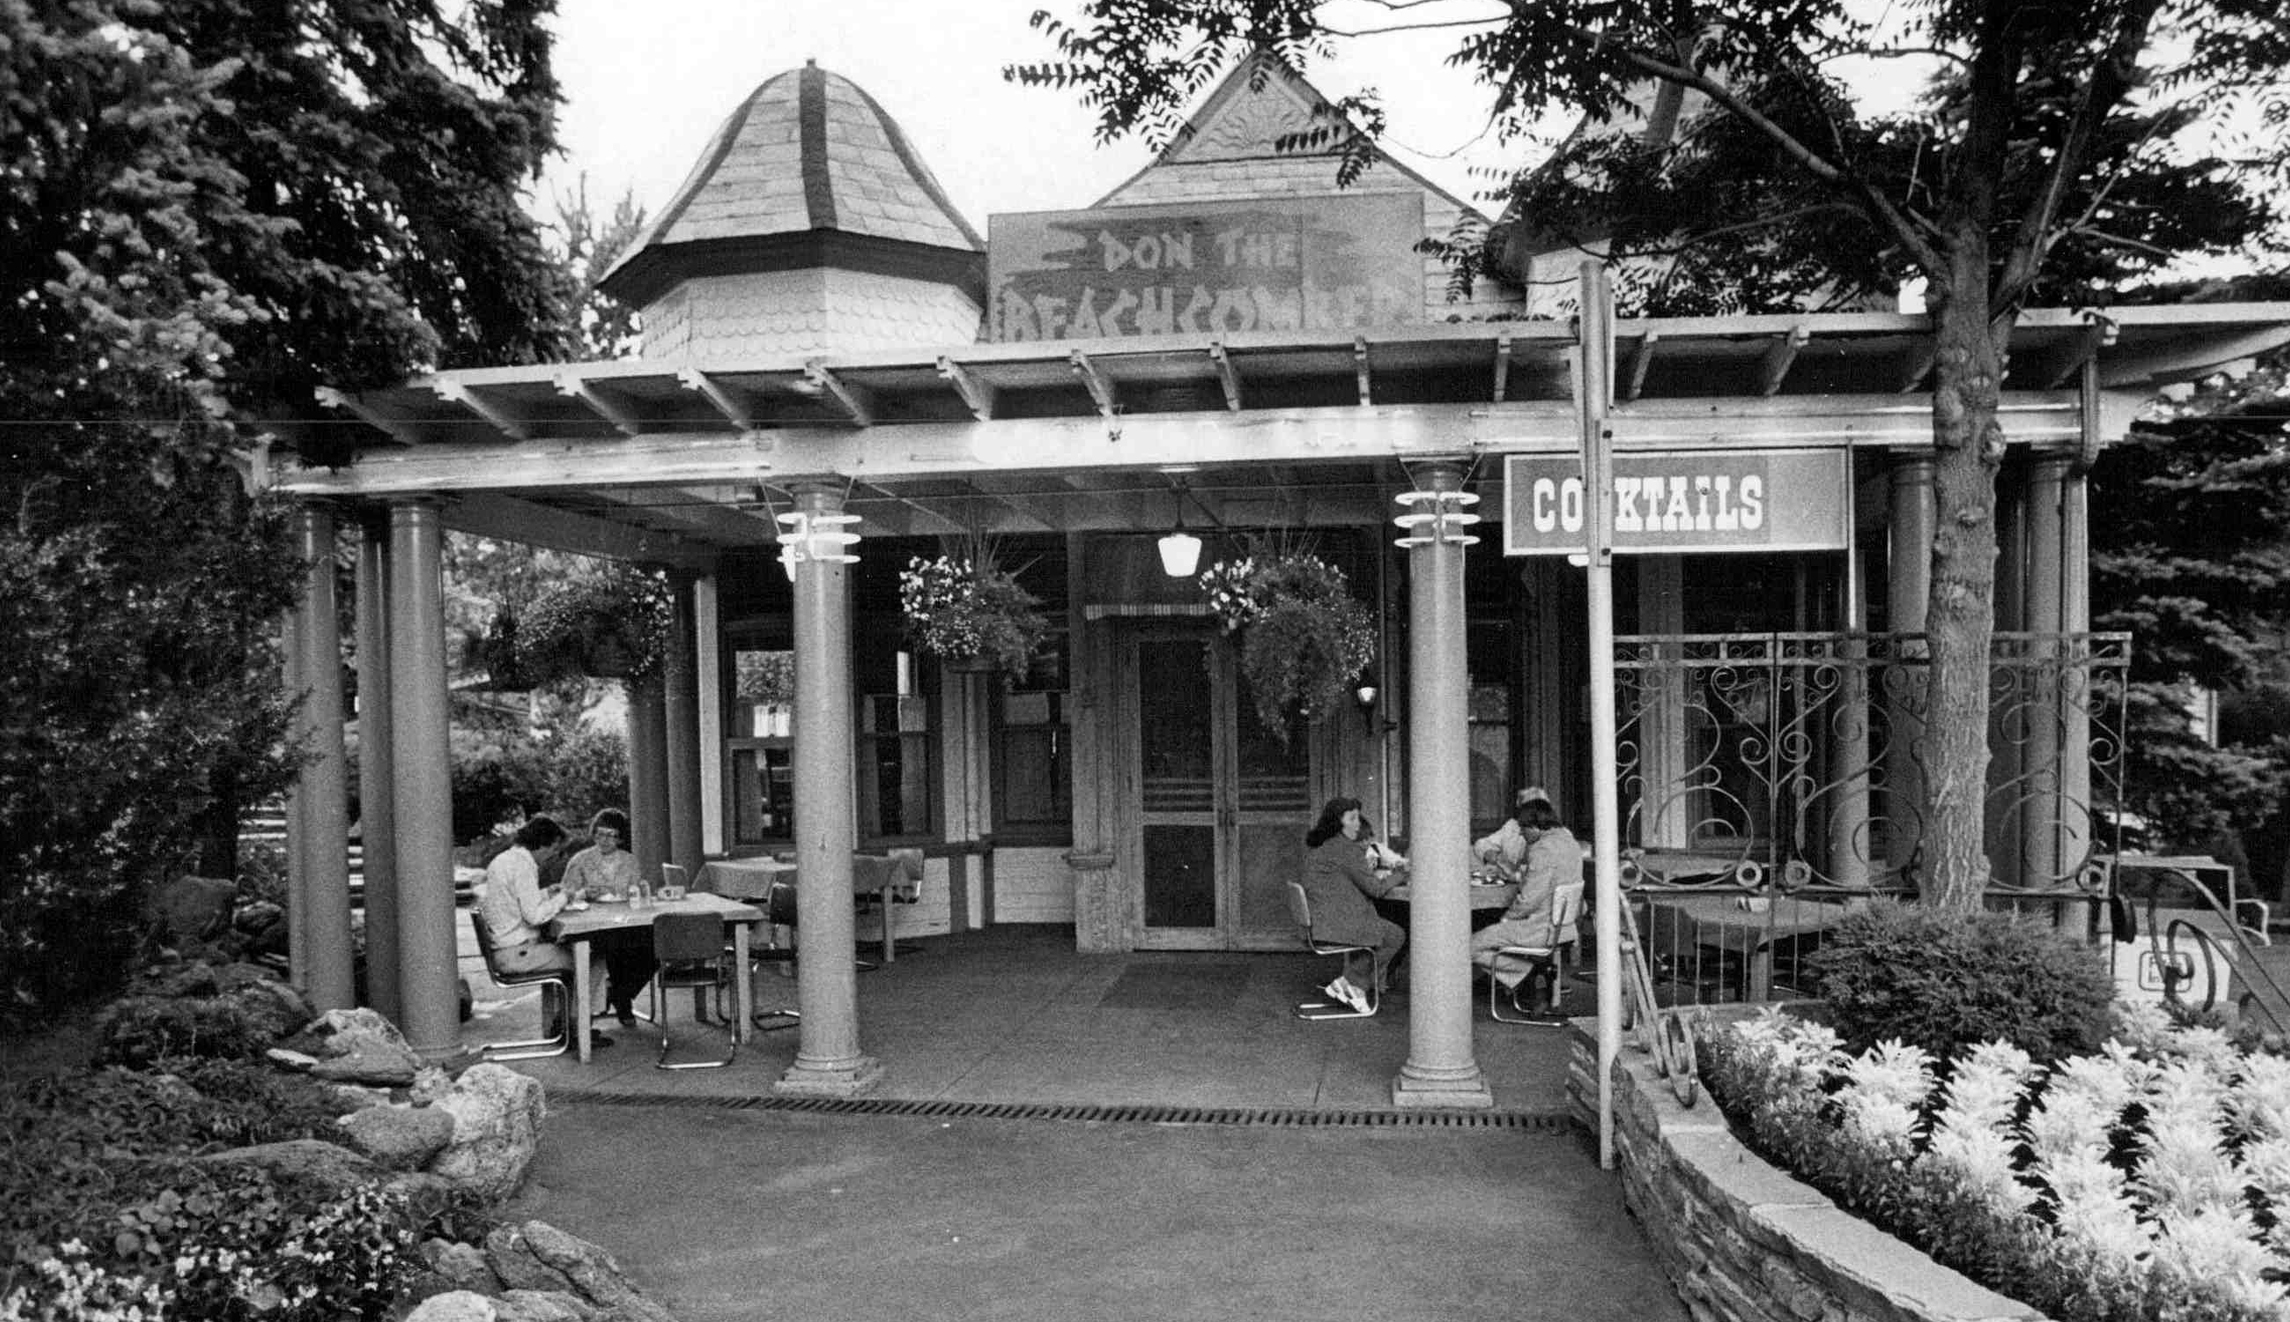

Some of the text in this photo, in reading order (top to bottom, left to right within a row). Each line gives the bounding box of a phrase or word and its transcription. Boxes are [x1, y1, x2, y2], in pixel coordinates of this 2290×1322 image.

[1098, 227, 1300, 272] DON THE
[1533, 474, 1764, 533] COKTAILS
